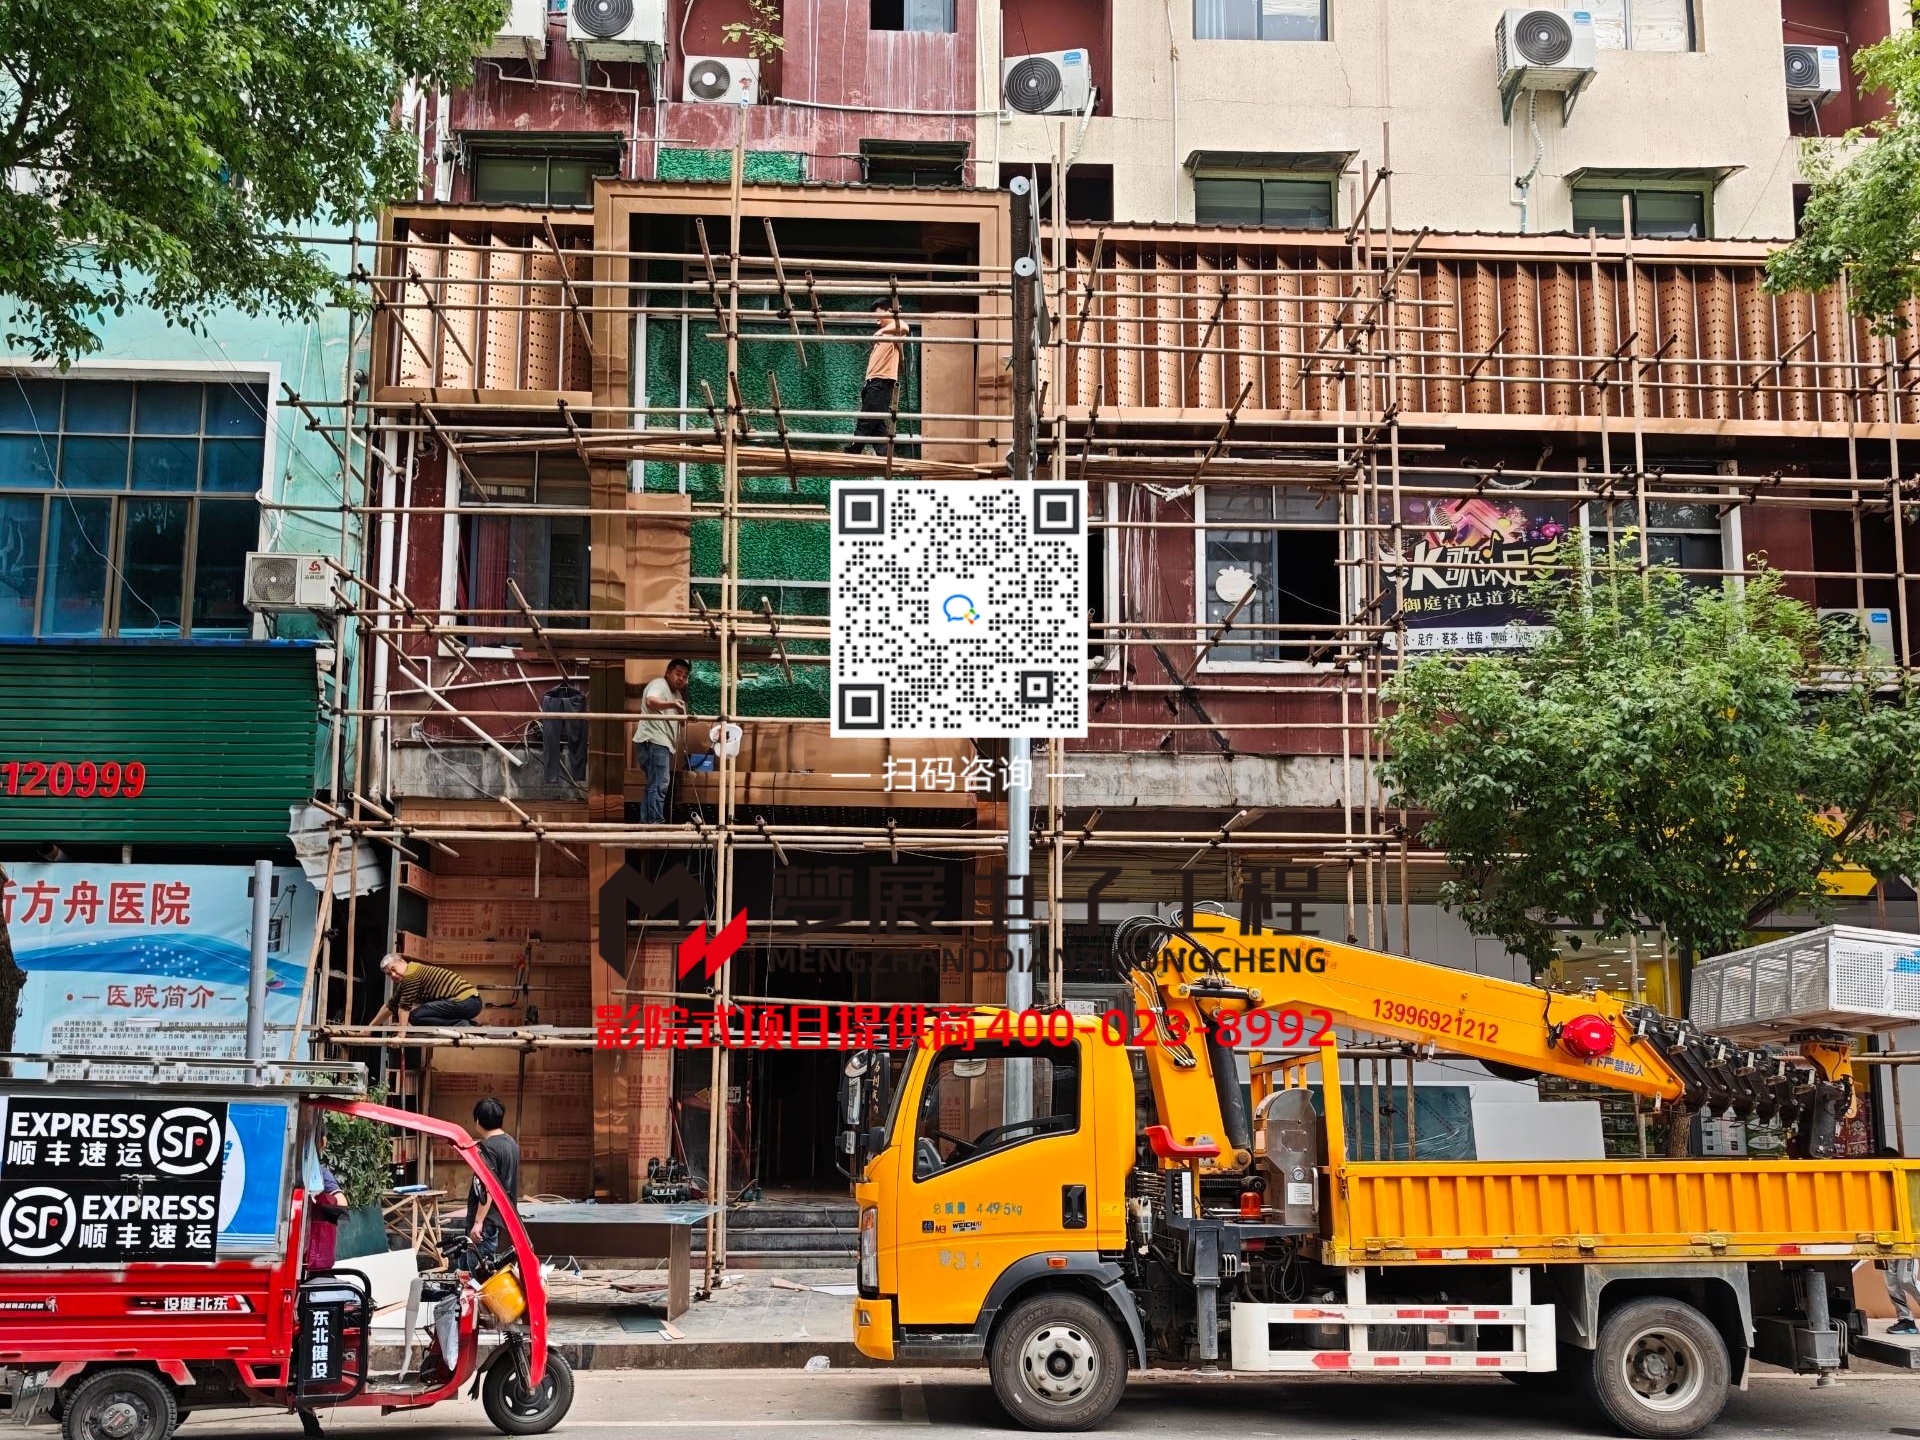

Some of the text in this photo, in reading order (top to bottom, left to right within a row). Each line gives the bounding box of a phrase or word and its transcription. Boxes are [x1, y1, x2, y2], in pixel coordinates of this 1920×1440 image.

[0, 760, 146, 798] 120999
[107, 983, 215, 1009] 医院简介
[1372, 998, 1499, 1044] 13996921212
[11, 1111, 147, 1139] EXPRESS
[7, 1140, 143, 1167] 顺丰速运
[81, 1195, 215, 1221] EXPRESS
[78, 1223, 212, 1249] 顺丰速运
[311, 1310, 330, 1379] 东北健设
